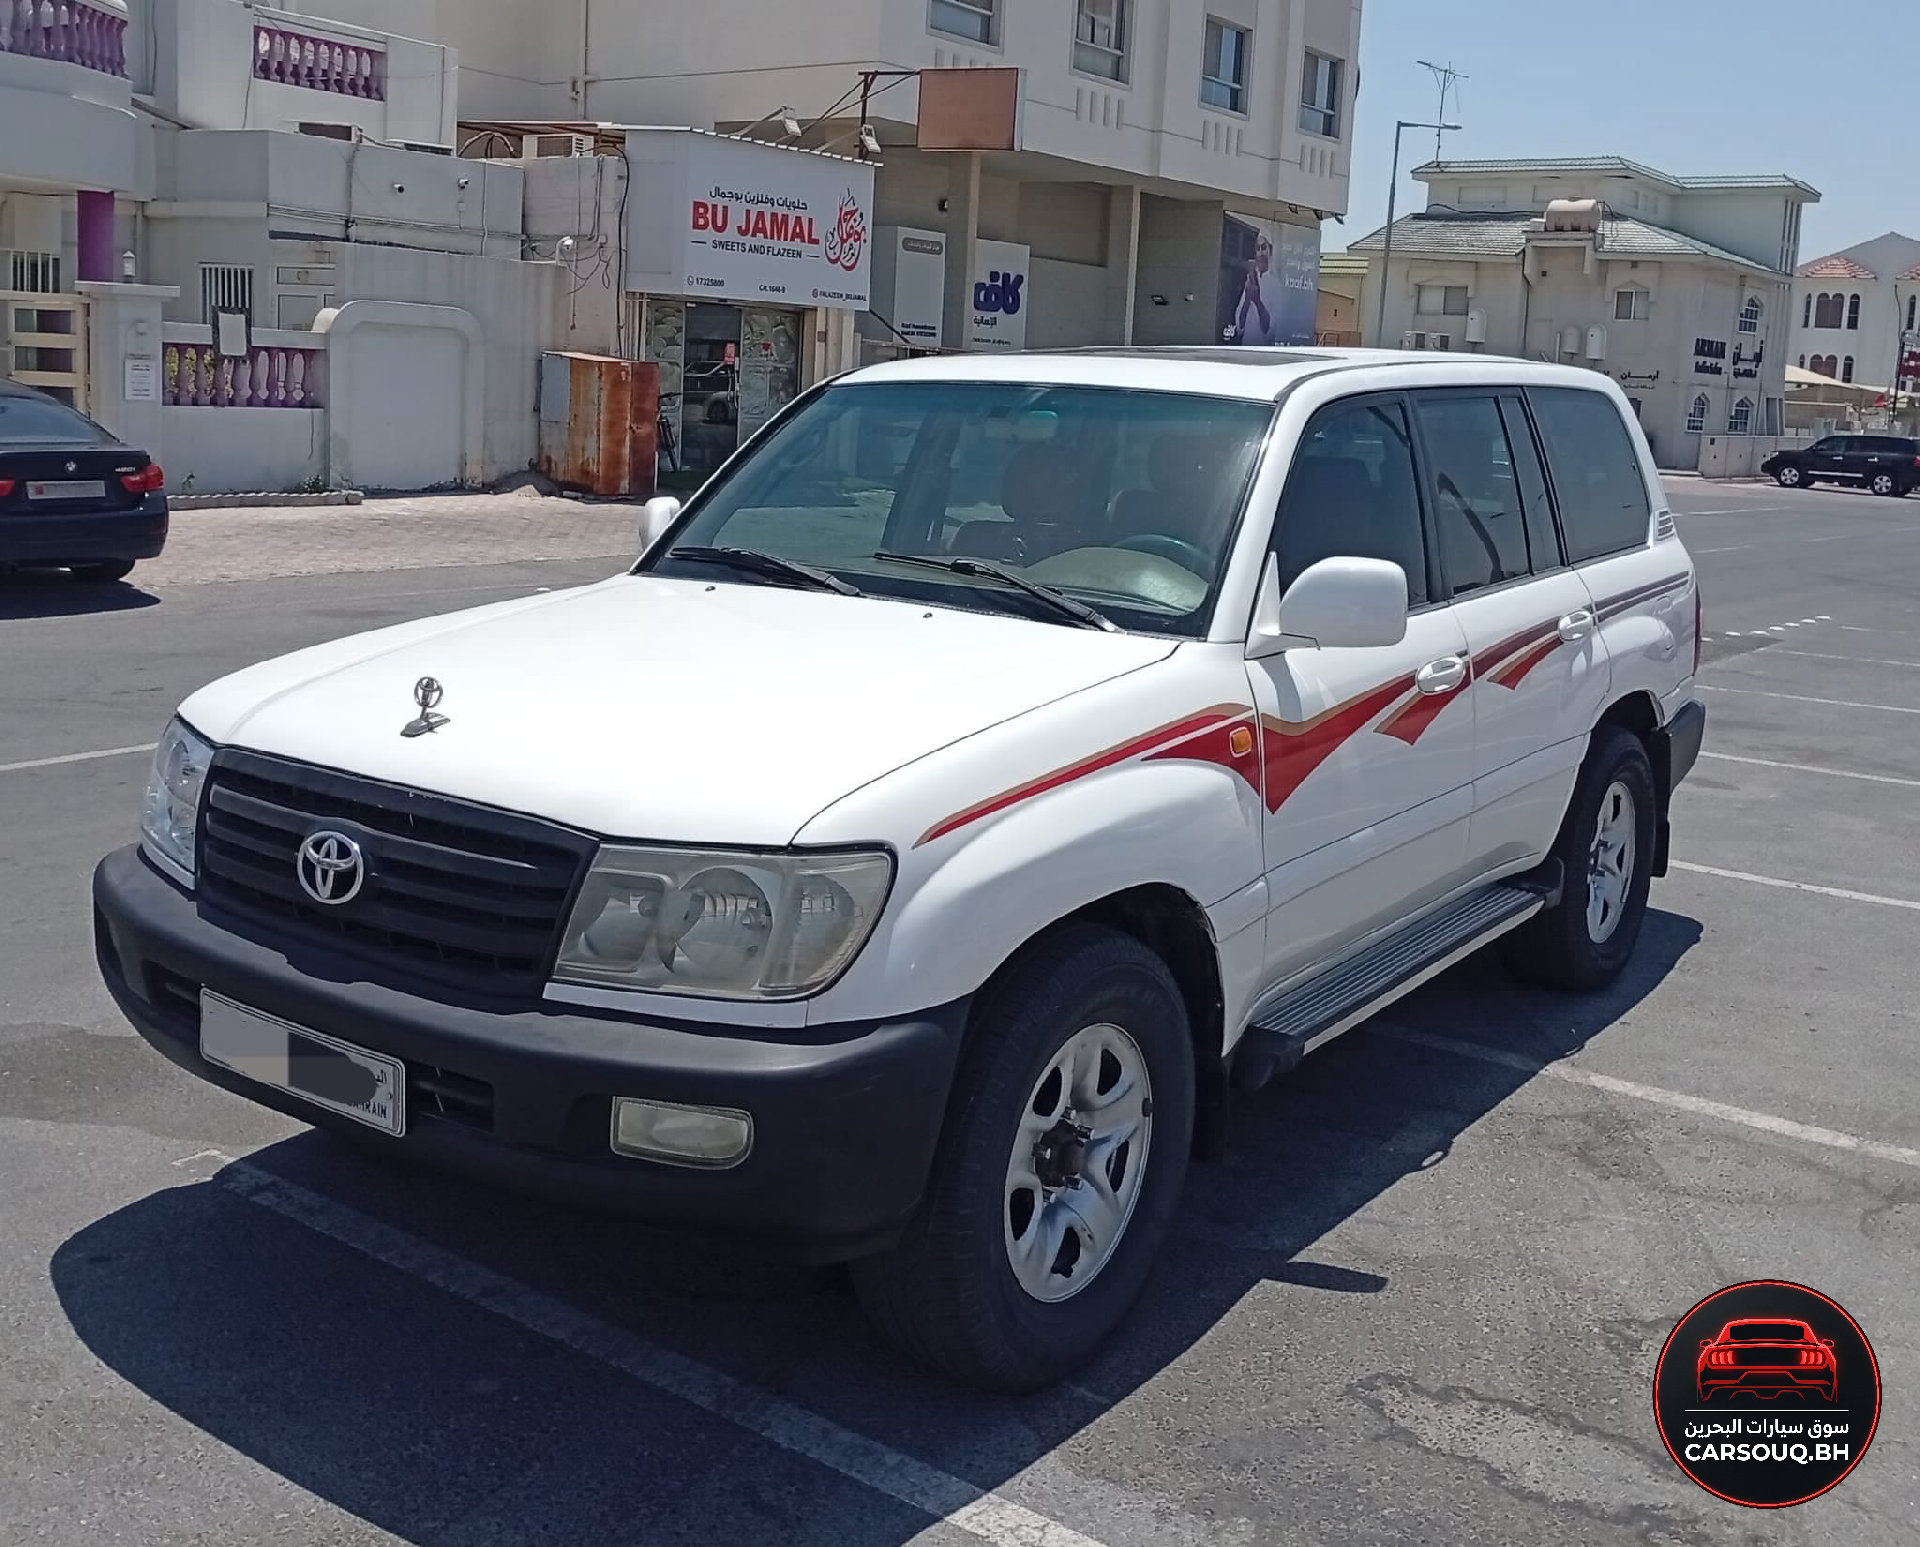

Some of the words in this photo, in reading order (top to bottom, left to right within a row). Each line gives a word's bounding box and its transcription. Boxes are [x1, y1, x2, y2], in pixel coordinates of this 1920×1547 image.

[692, 201, 729, 233] BU
[736, 209, 820, 245] JAMAL
[712, 239, 746, 253] SWEETS
[747, 244, 765, 256] AND
[766, 246, 802, 258] FLAZEEN
